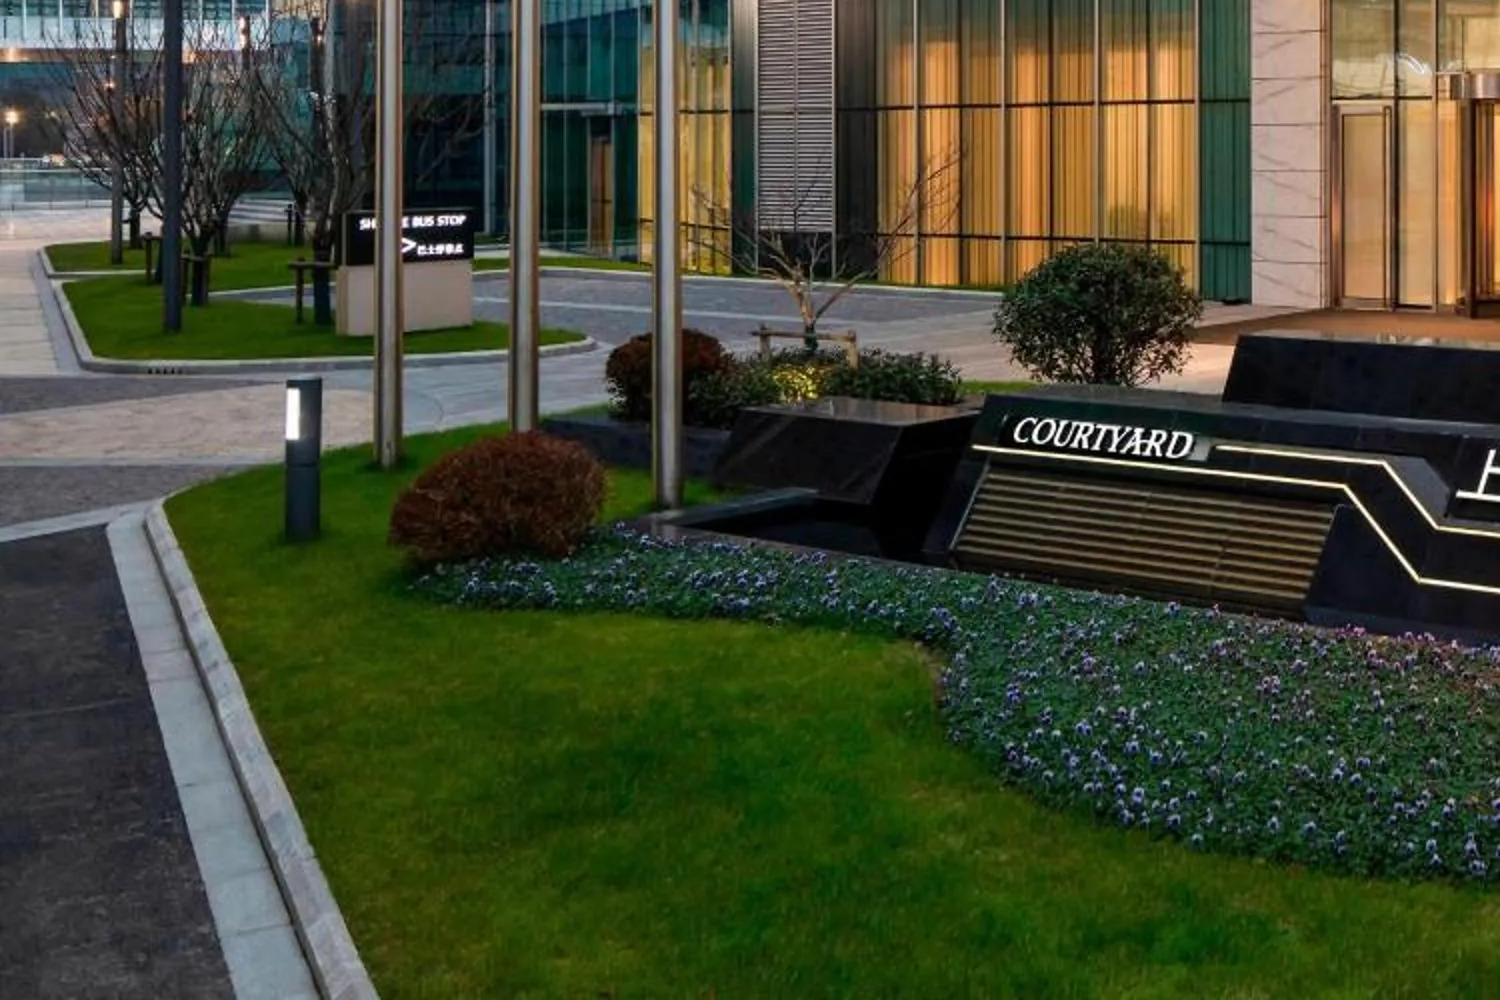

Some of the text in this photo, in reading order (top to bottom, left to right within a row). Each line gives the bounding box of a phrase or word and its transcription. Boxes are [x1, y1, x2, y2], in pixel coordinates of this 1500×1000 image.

[411, 215, 435, 228] BUS
[437, 214, 466, 227] STOP
[1012, 416, 1194, 460] COURTYARD
